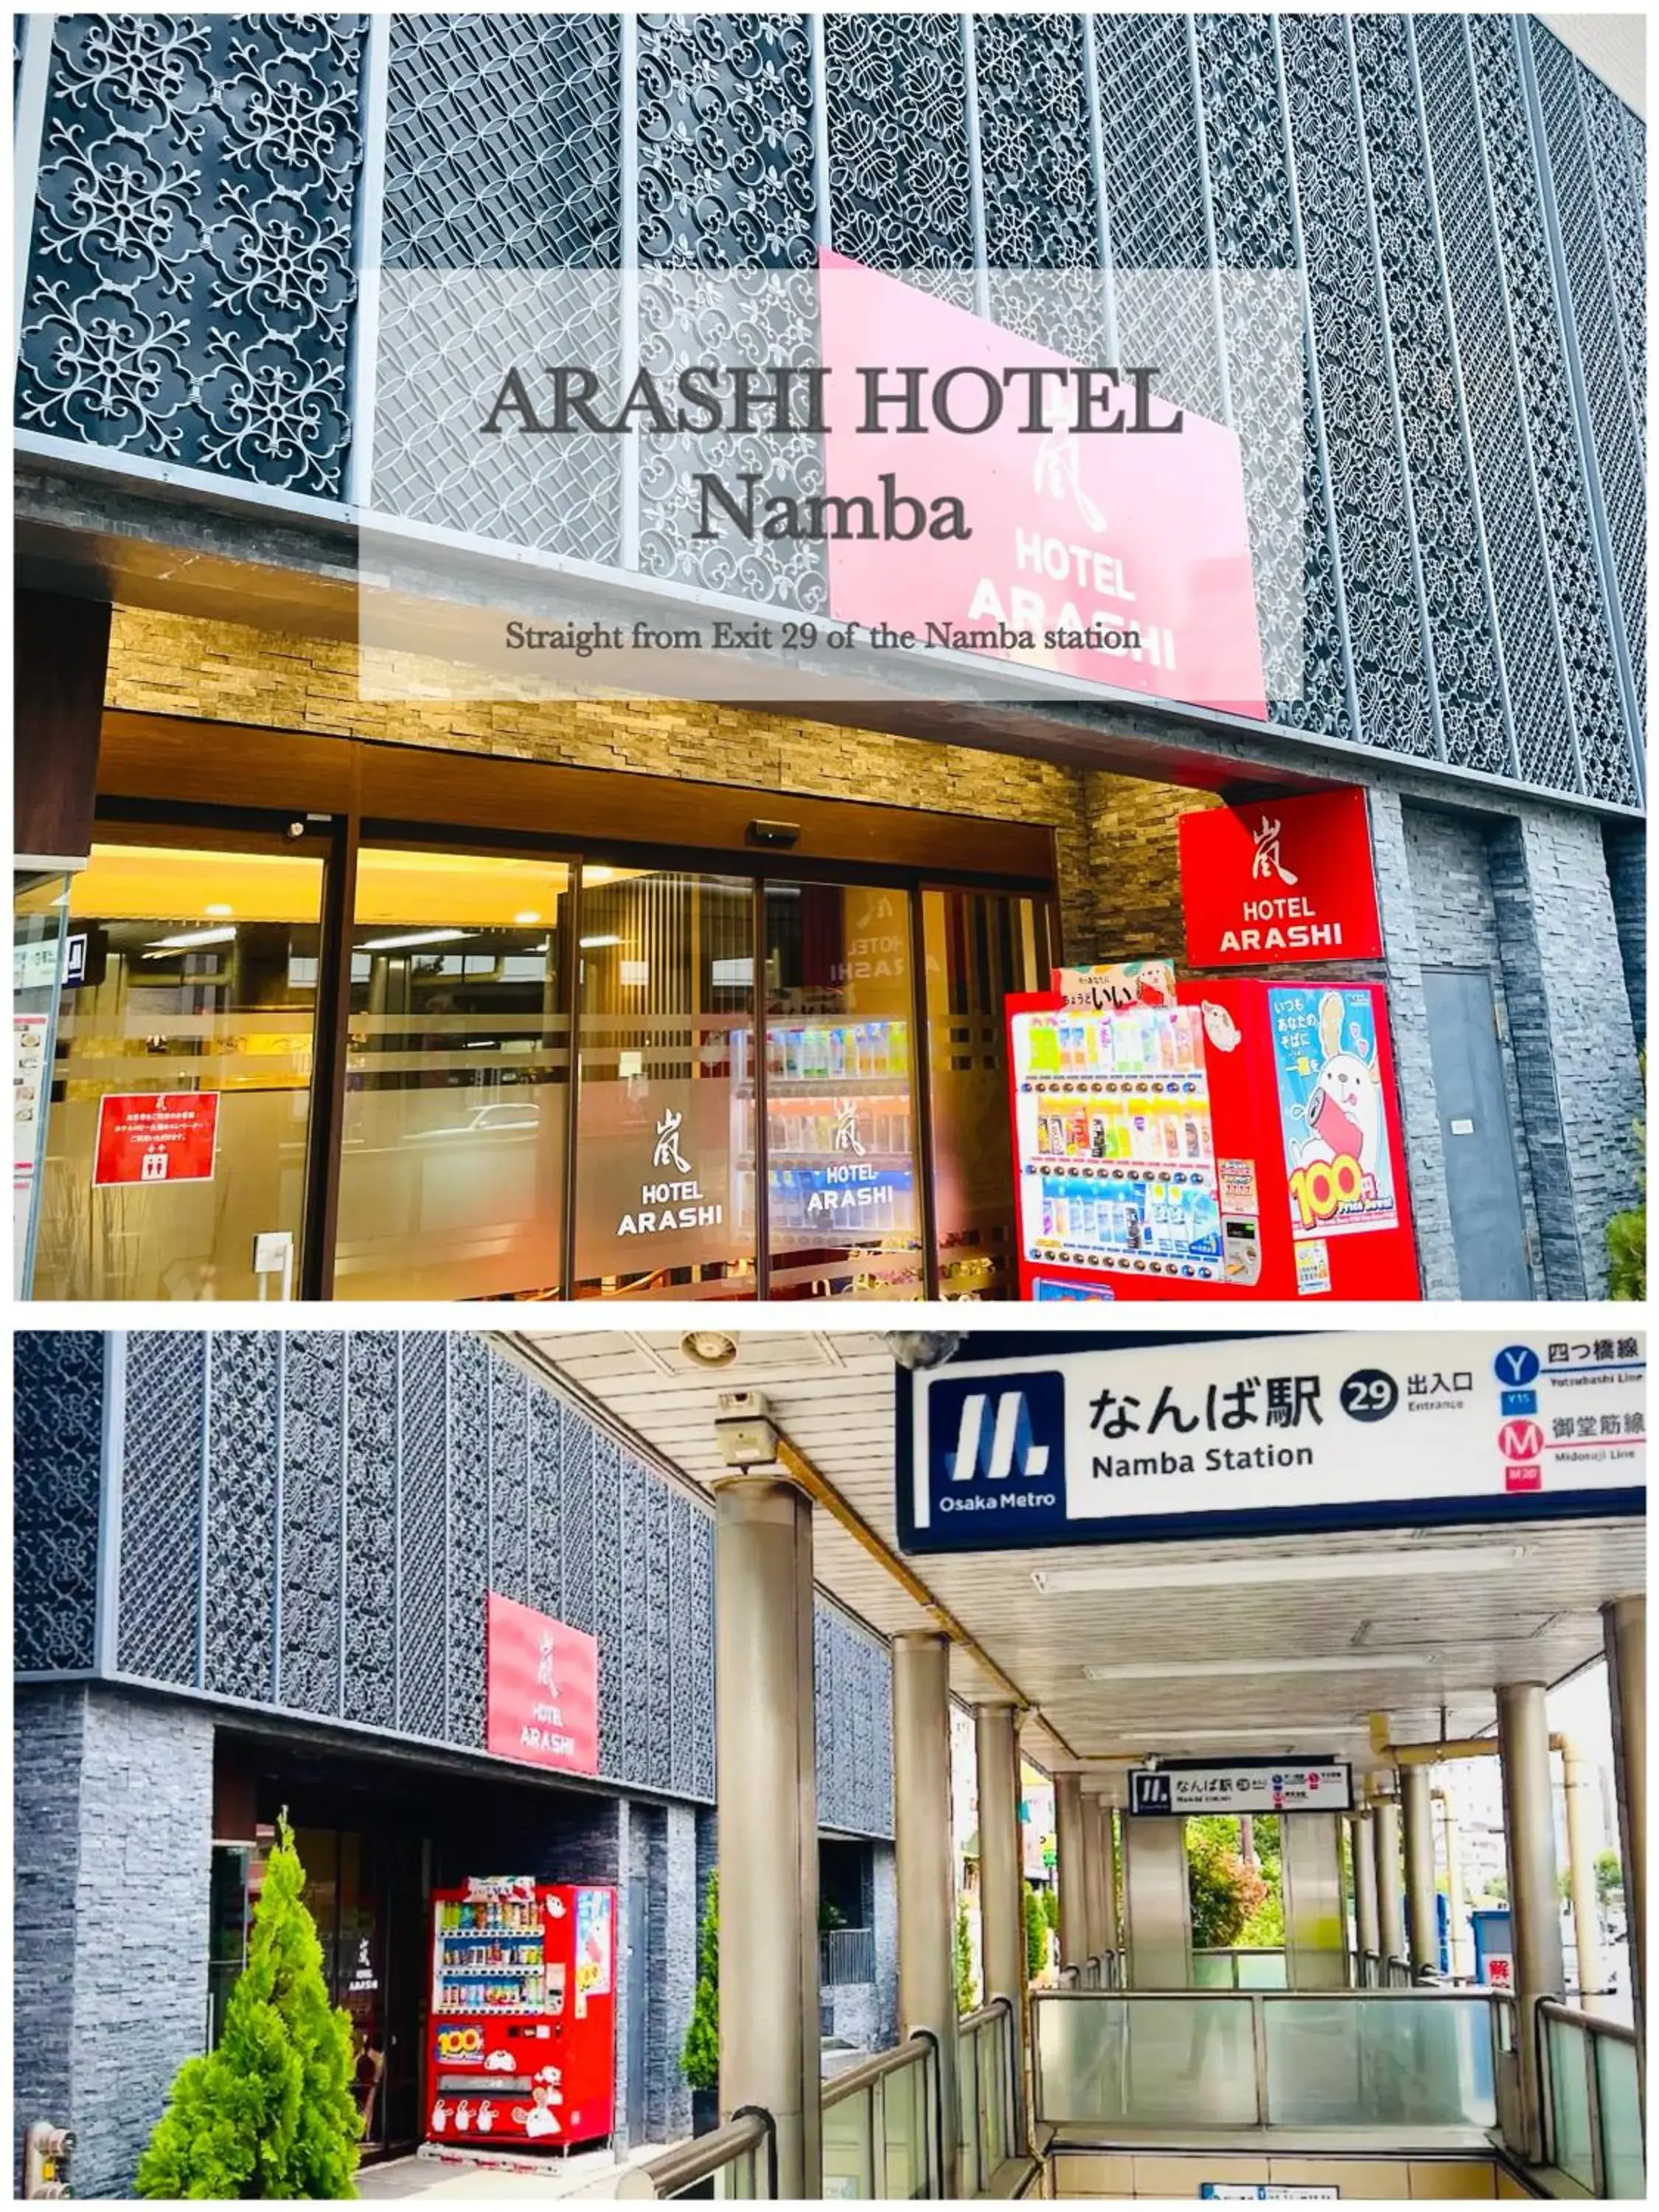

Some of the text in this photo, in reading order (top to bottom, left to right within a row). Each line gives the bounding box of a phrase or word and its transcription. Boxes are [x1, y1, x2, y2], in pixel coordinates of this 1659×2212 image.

[1015, 527, 1136, 602] HOTEL
[967, 578, 1176, 670] ARASHI
[1244, 897, 1315, 921] HOTEL
[1220, 923, 1343, 951] ARASHI
[827, 1163, 876, 1183] HOTEL
[641, 1181, 703, 1204] HOTEL
[807, 1186, 894, 1212] ARASHI
[617, 1205, 722, 1236] ARASHI
[1548, 1337, 1638, 1363] 四つ橋線
[1504, 1351, 1528, 1381] Y
[1408, 1371, 1473, 1396] 出入口
[1551, 1373, 1644, 1388] Yotsubashi Line
[1089, 1375, 1324, 1439] なんば駅
[1347, 1380, 1392, 1411] 29
[1408, 1399, 1464, 1412] Entrance
[1552, 1412, 1646, 1439] 御堂筋線
[1503, 1425, 1539, 1455] M
[1092, 1444, 1314, 1478] Namba Station
[1610, 1450, 1635, 1459] Line
[939, 1492, 1056, 1512] Osaka Metro
[520, 1726, 575, 1756] ARASHI
[1176, 1777, 1234, 1793] なんば駅
